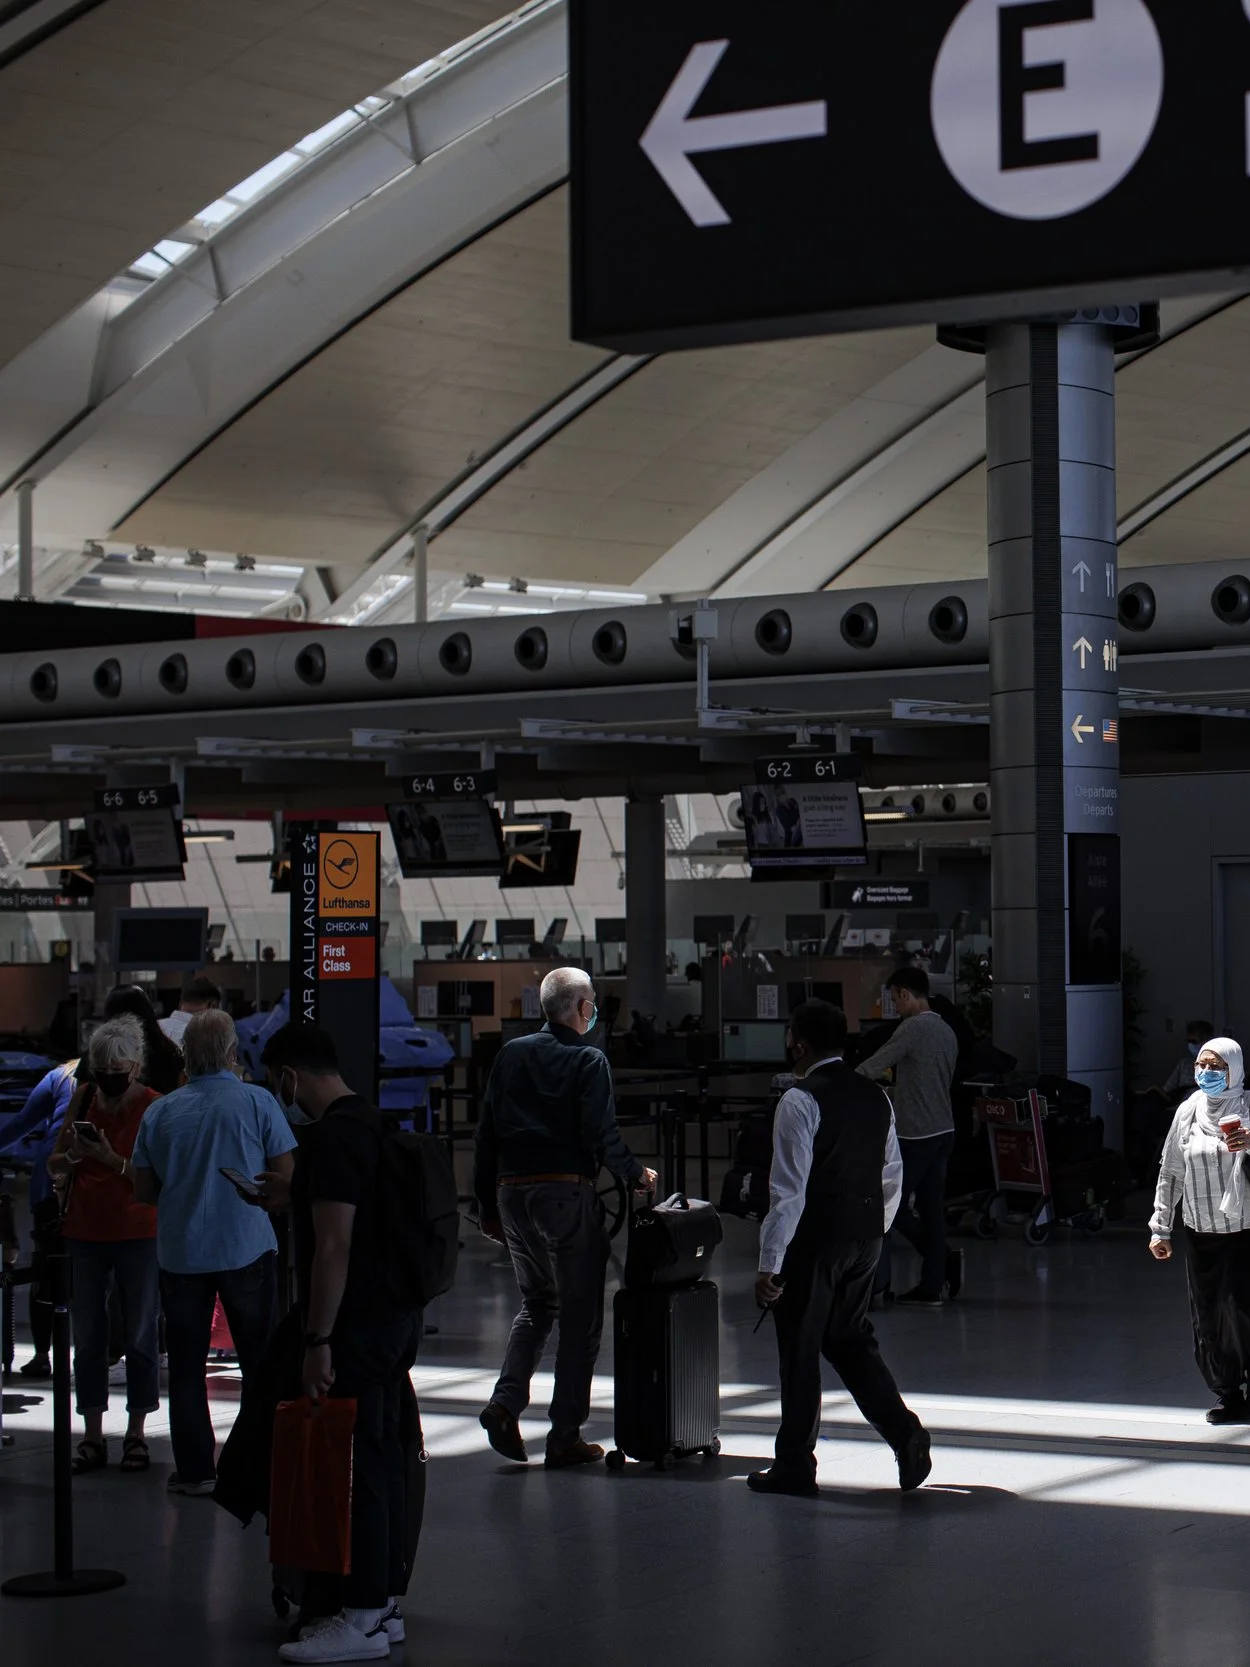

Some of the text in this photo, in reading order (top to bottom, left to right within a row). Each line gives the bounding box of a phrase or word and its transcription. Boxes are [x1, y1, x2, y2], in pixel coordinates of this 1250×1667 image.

[999, 0, 1101, 173] E
[767, 760, 836, 778] 6-2 6-1
[412, 775, 476, 793] 6-4 6-3
[1074, 784, 1118, 800] Departures
[103, 789, 158, 806] 6-6 6-5
[20, 893, 54, 906] Portes
[322, 897, 371, 909] Lufthansa
[303, 861, 316, 981] ALLIANCE
[325, 922, 369, 932] CHECK-IN
[322, 944, 346, 957] First
[322, 959, 351, 972] Class
[302, 988, 316, 1025] AR
